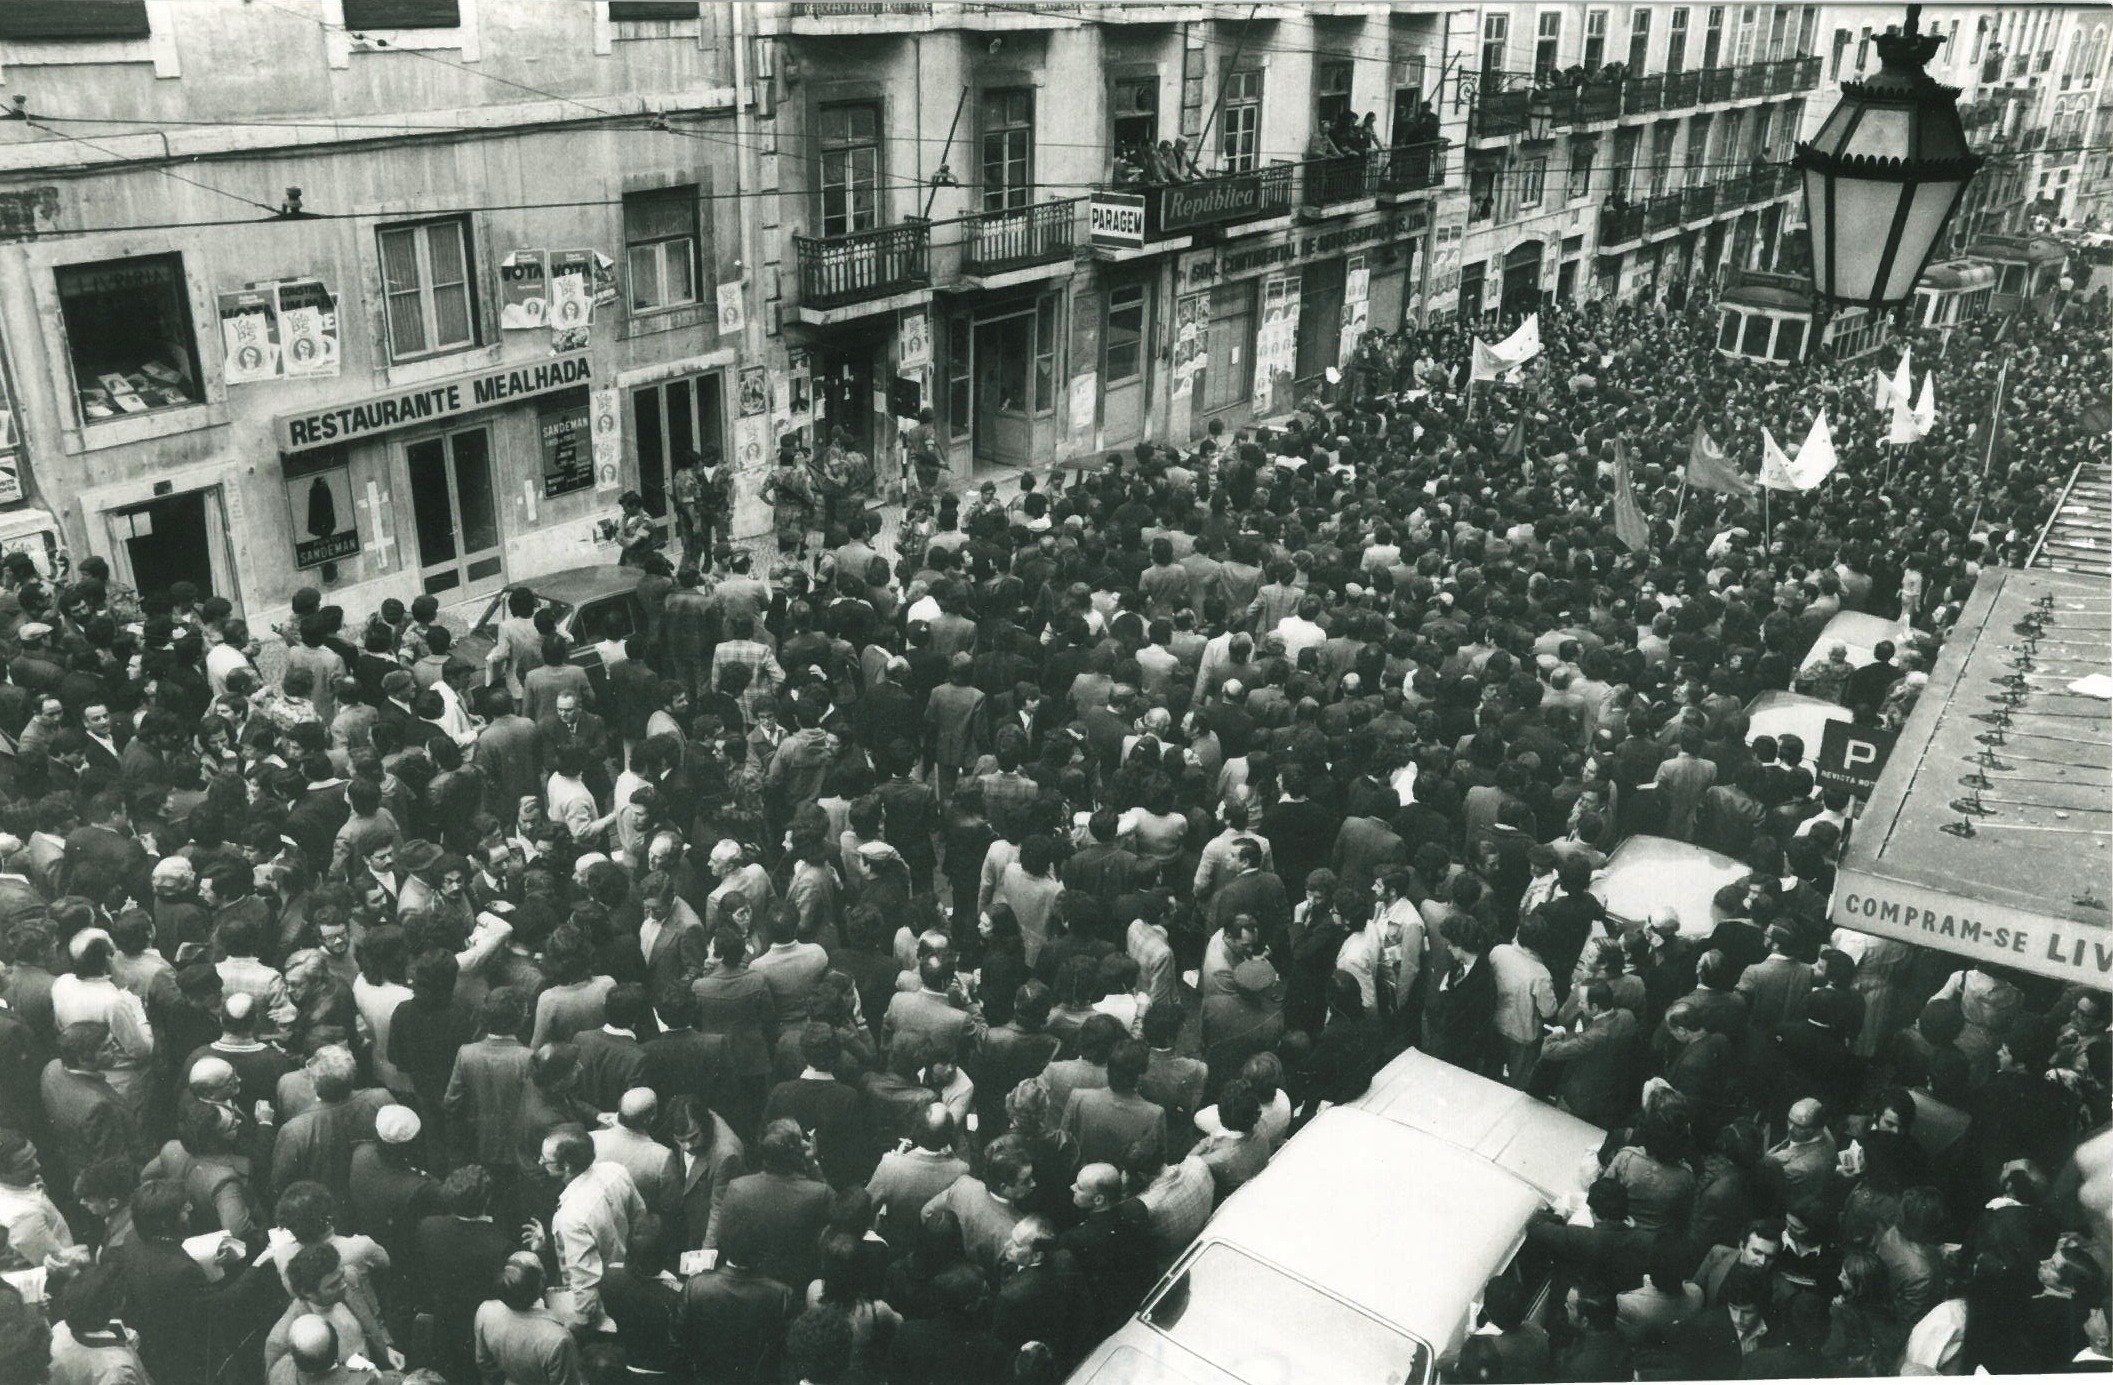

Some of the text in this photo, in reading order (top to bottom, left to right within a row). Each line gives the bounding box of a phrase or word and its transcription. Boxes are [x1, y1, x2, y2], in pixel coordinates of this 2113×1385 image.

[1169, 184, 1254, 221] República
[1092, 208, 1142, 234] PARAGEM
[501, 262, 545, 281] VOTA
[289, 357, 591, 446] RESTAURANTE MEALHADA
[542, 416, 589, 438] SANDEMAN
[300, 538, 357, 564] SANDEMAN
[1843, 739, 1878, 770] P
[1845, 893, 2029, 953] COMPRAM-SE
